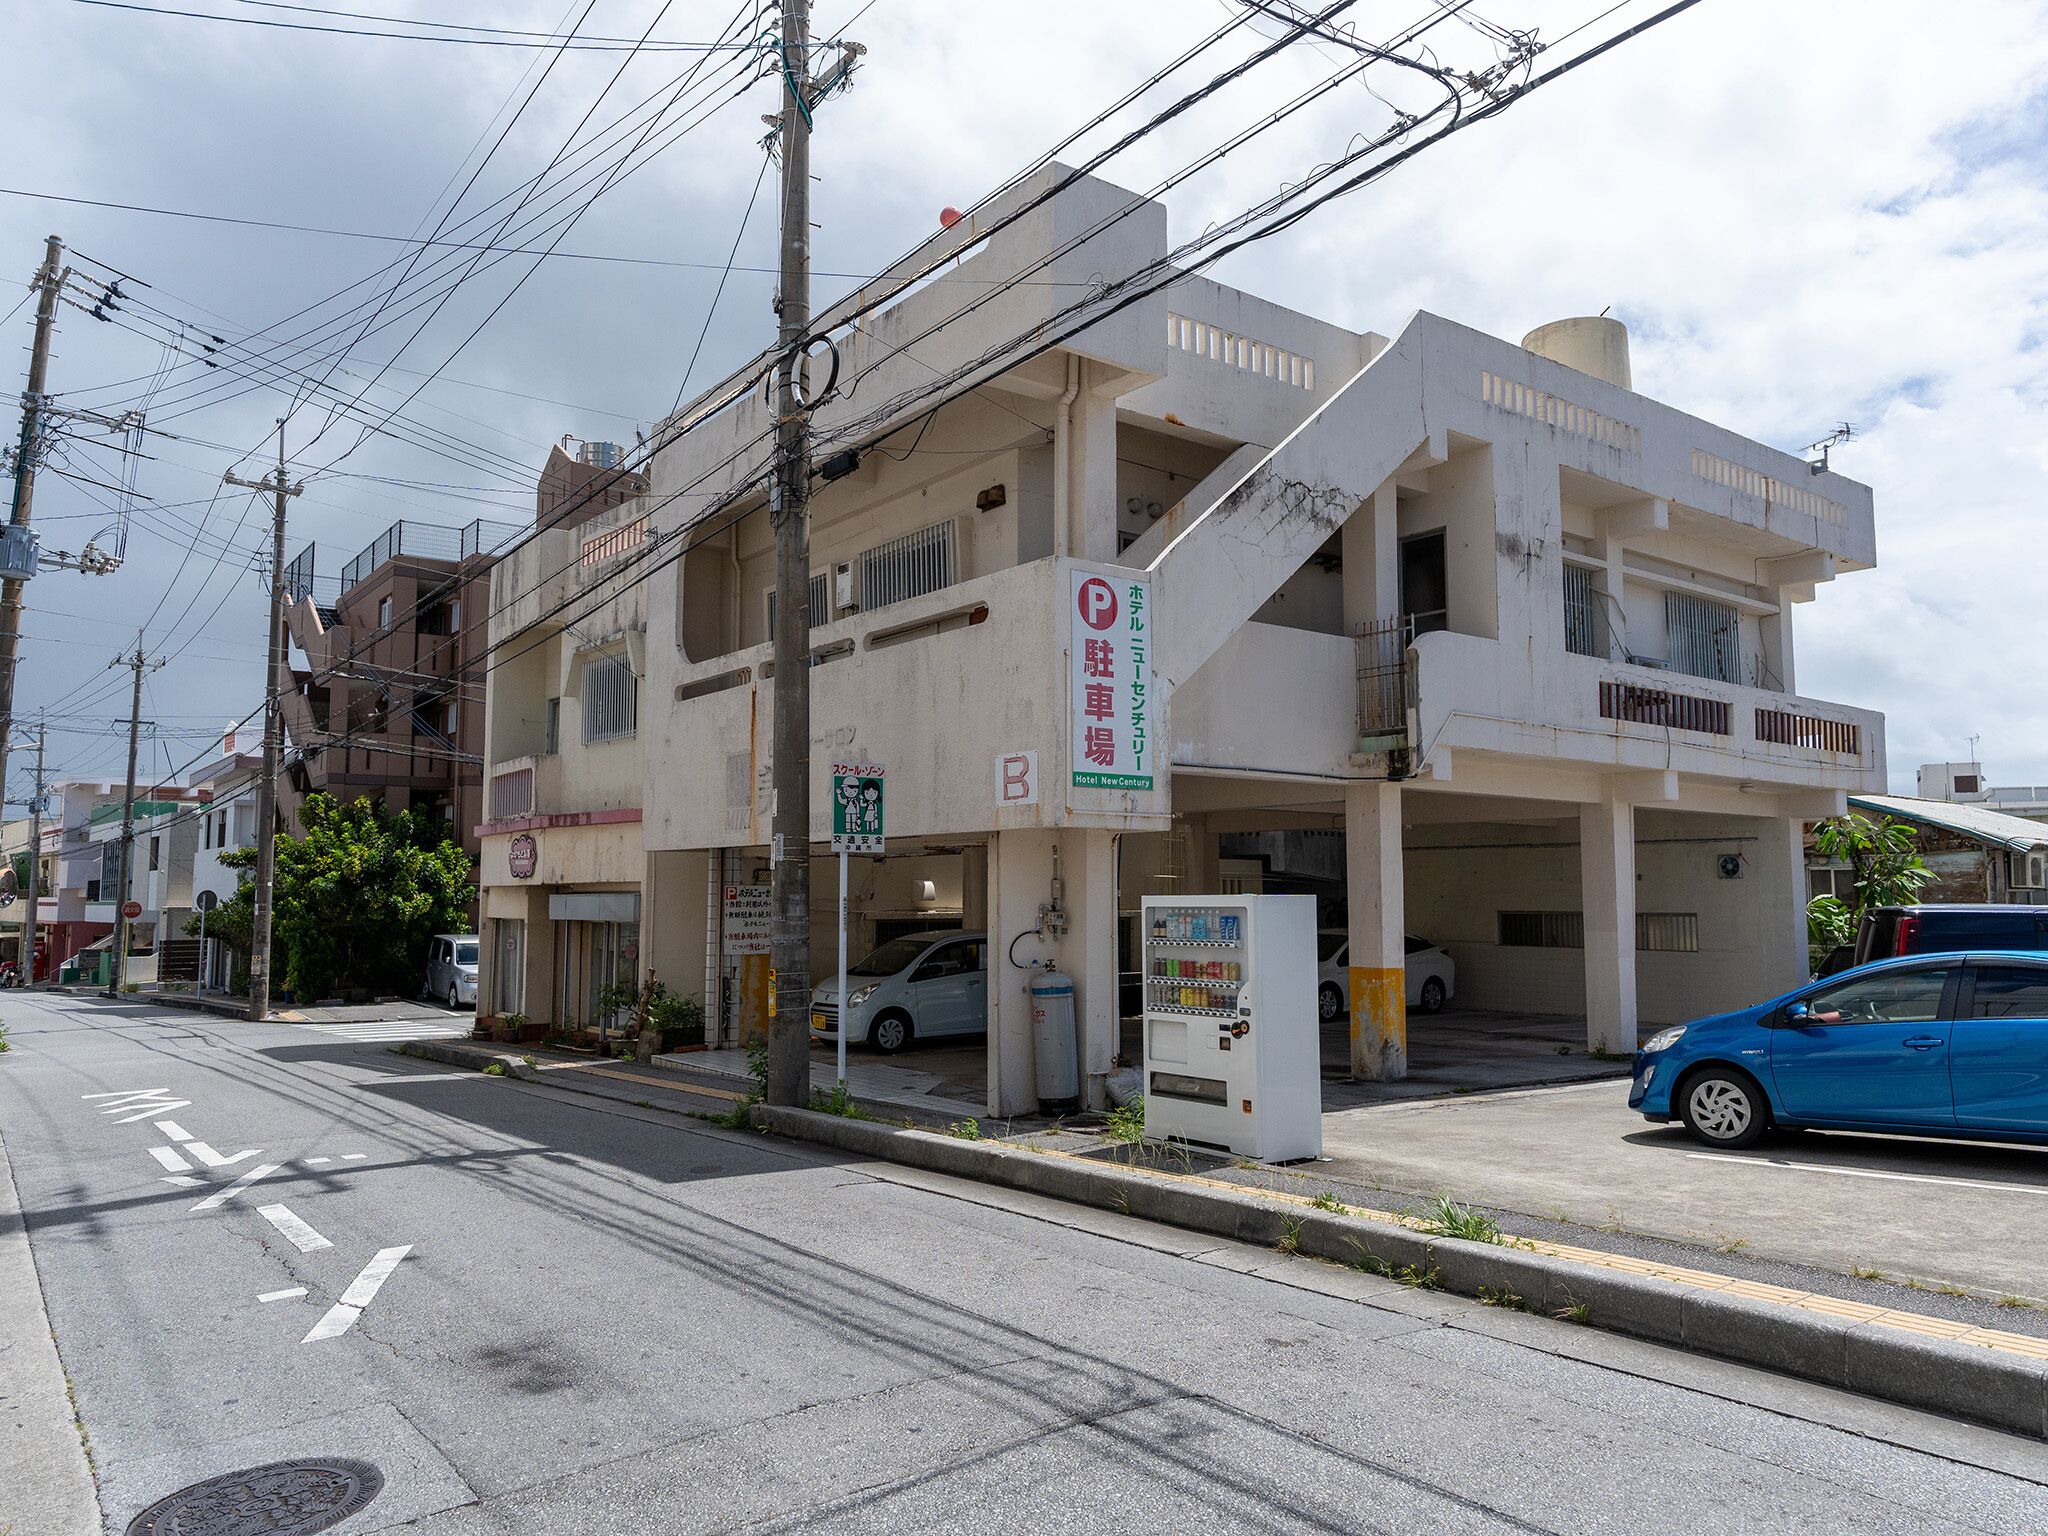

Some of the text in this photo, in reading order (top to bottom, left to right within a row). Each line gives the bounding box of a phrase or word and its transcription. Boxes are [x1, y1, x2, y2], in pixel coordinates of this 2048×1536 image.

[1088, 583, 1112, 624] P
[1129, 585, 1146, 771] ホテル ニューセンチュリー
[1083, 638, 1115, 767] 駐車場
[833, 764, 885, 777] スクール・ゾーン
[1003, 755, 1030, 801] B
[1075, 775, 1098, 785] Hotel
[833, 834, 883, 845] 交通安全
[727, 887, 736, 899] P
